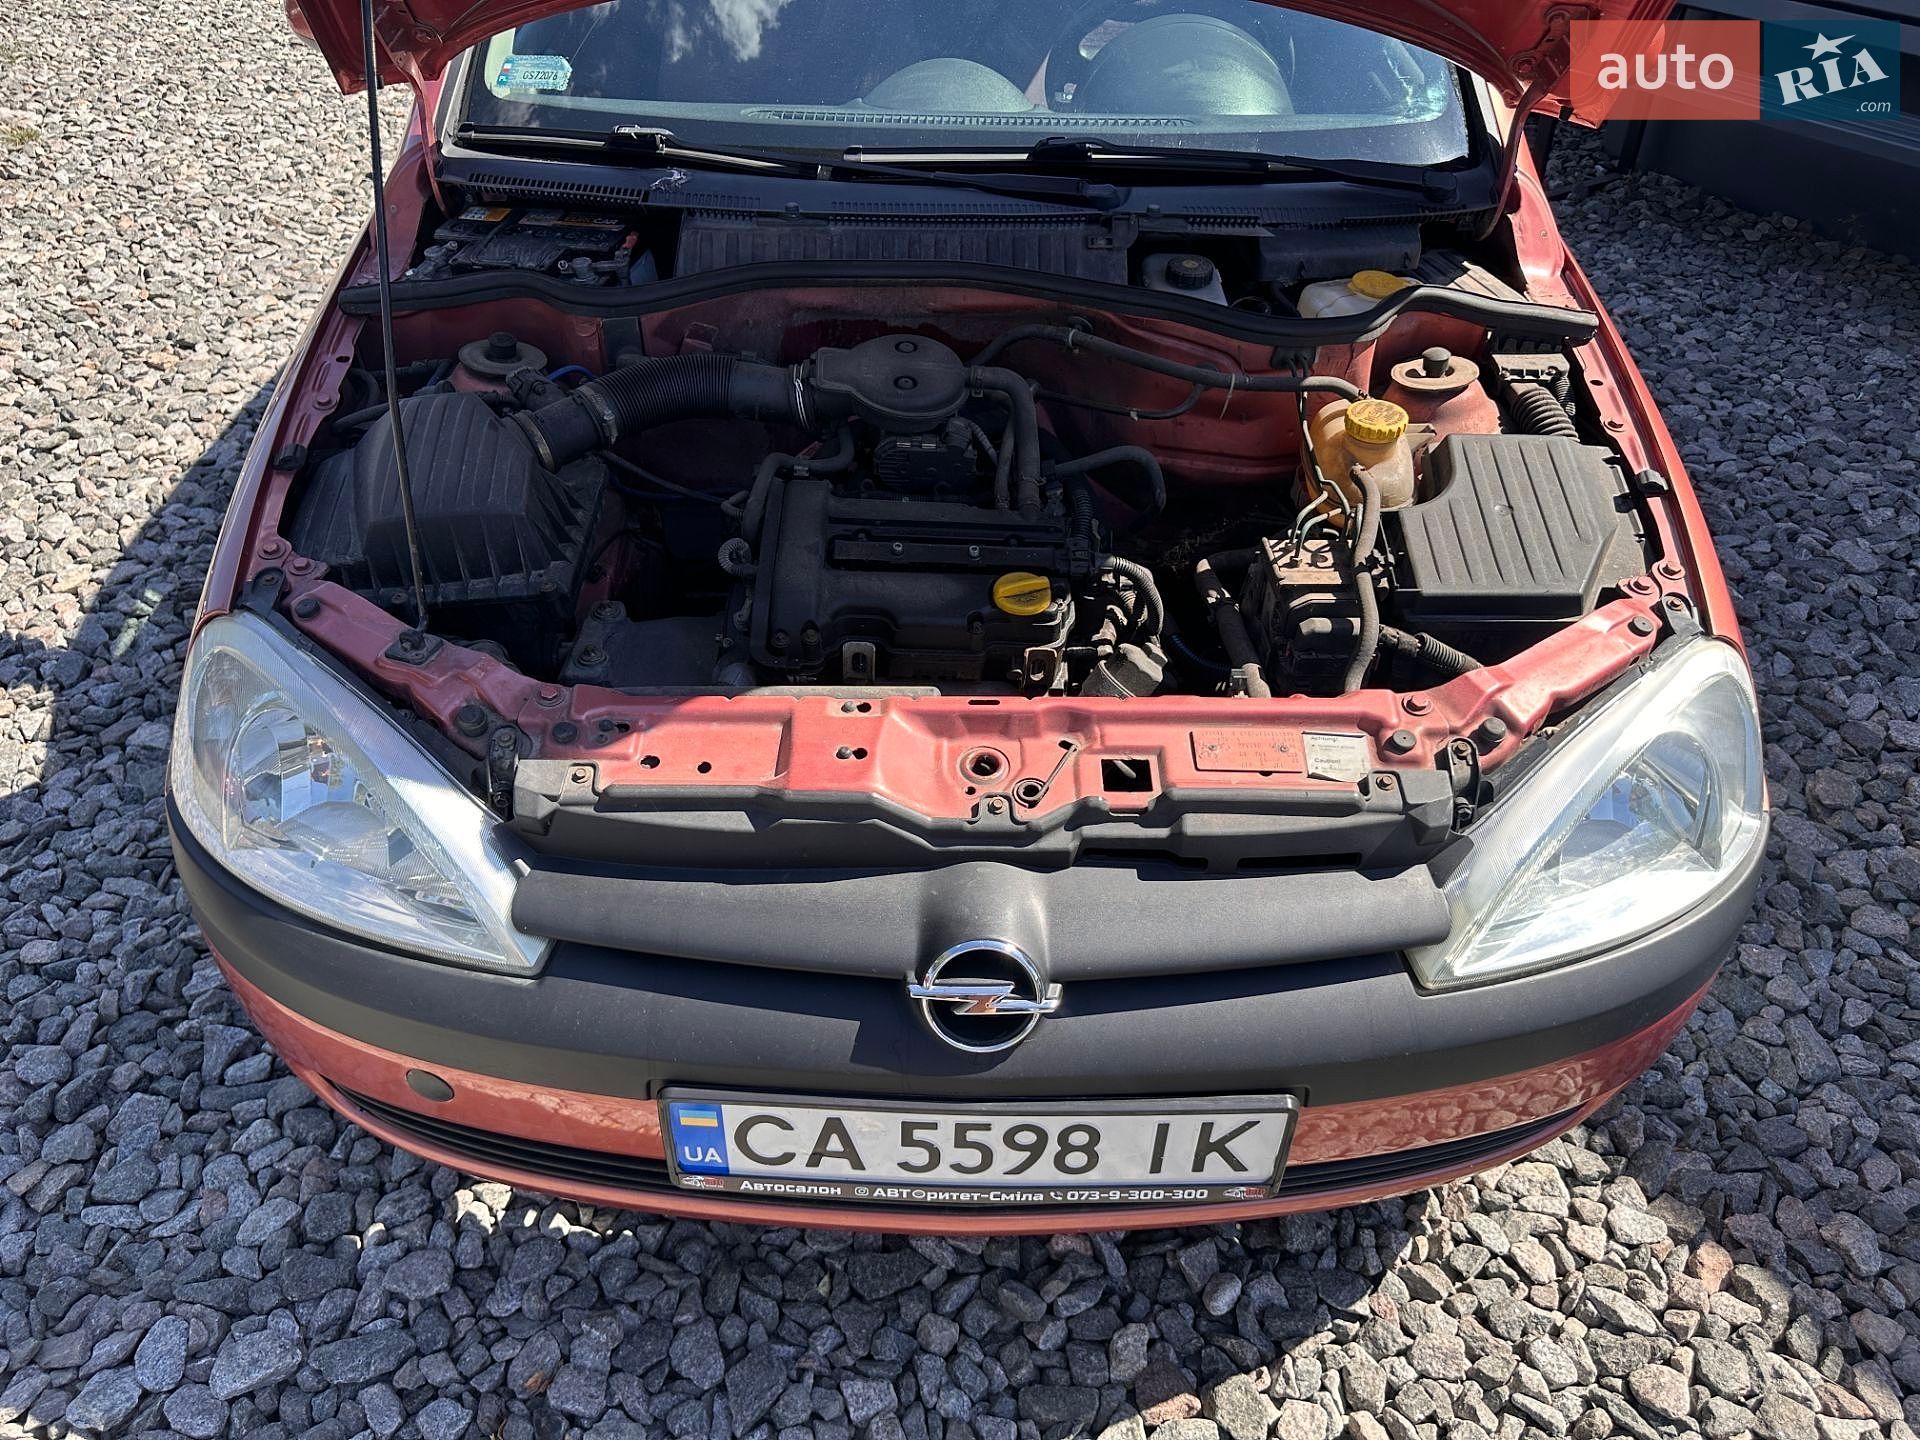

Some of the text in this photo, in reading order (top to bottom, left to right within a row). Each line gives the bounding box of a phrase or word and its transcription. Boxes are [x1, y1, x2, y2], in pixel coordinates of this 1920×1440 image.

[683, 1146, 723, 1164] UA
[733, 1114, 1261, 1175] CA 5598 IK
[739, 1180, 842, 1196] Автосалон
[1066, 1189, 1208, 1201] 073-9-300-300
